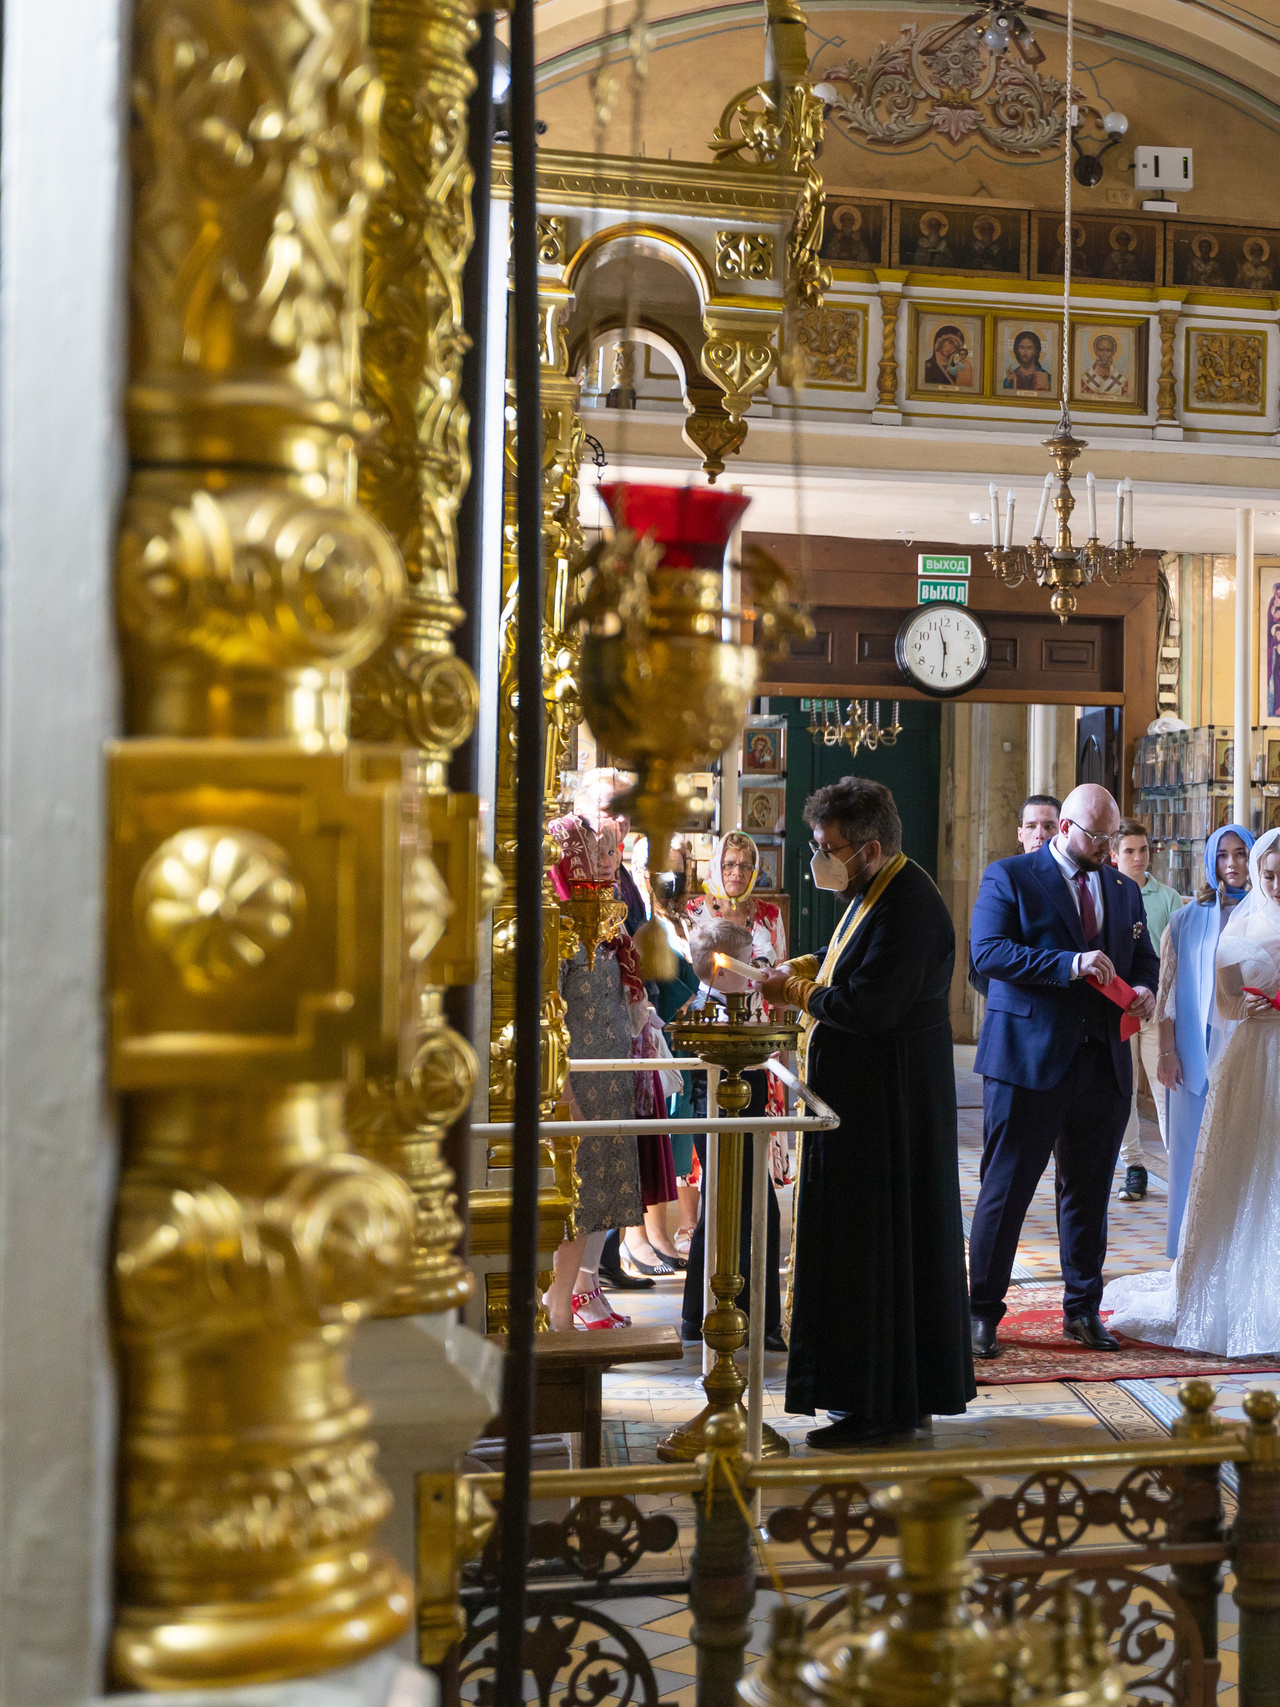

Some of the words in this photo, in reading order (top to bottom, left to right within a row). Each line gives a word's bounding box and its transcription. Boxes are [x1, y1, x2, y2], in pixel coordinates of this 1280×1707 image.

[926, 560, 966, 572] ВЫХОД
[922, 585, 965, 602] ВЫХОД
[929, 621, 937, 631] 11
[940, 617, 950, 627] 12
[919, 631, 930, 641] 10
[964, 630, 970, 640] 2
[914, 643, 921, 652] 9
[969, 643, 976, 653] 3
[918, 655, 926, 665] 8
[964, 656, 970, 666] 4
[929, 664, 936, 675] 7
[955, 665, 962, 676] 5
